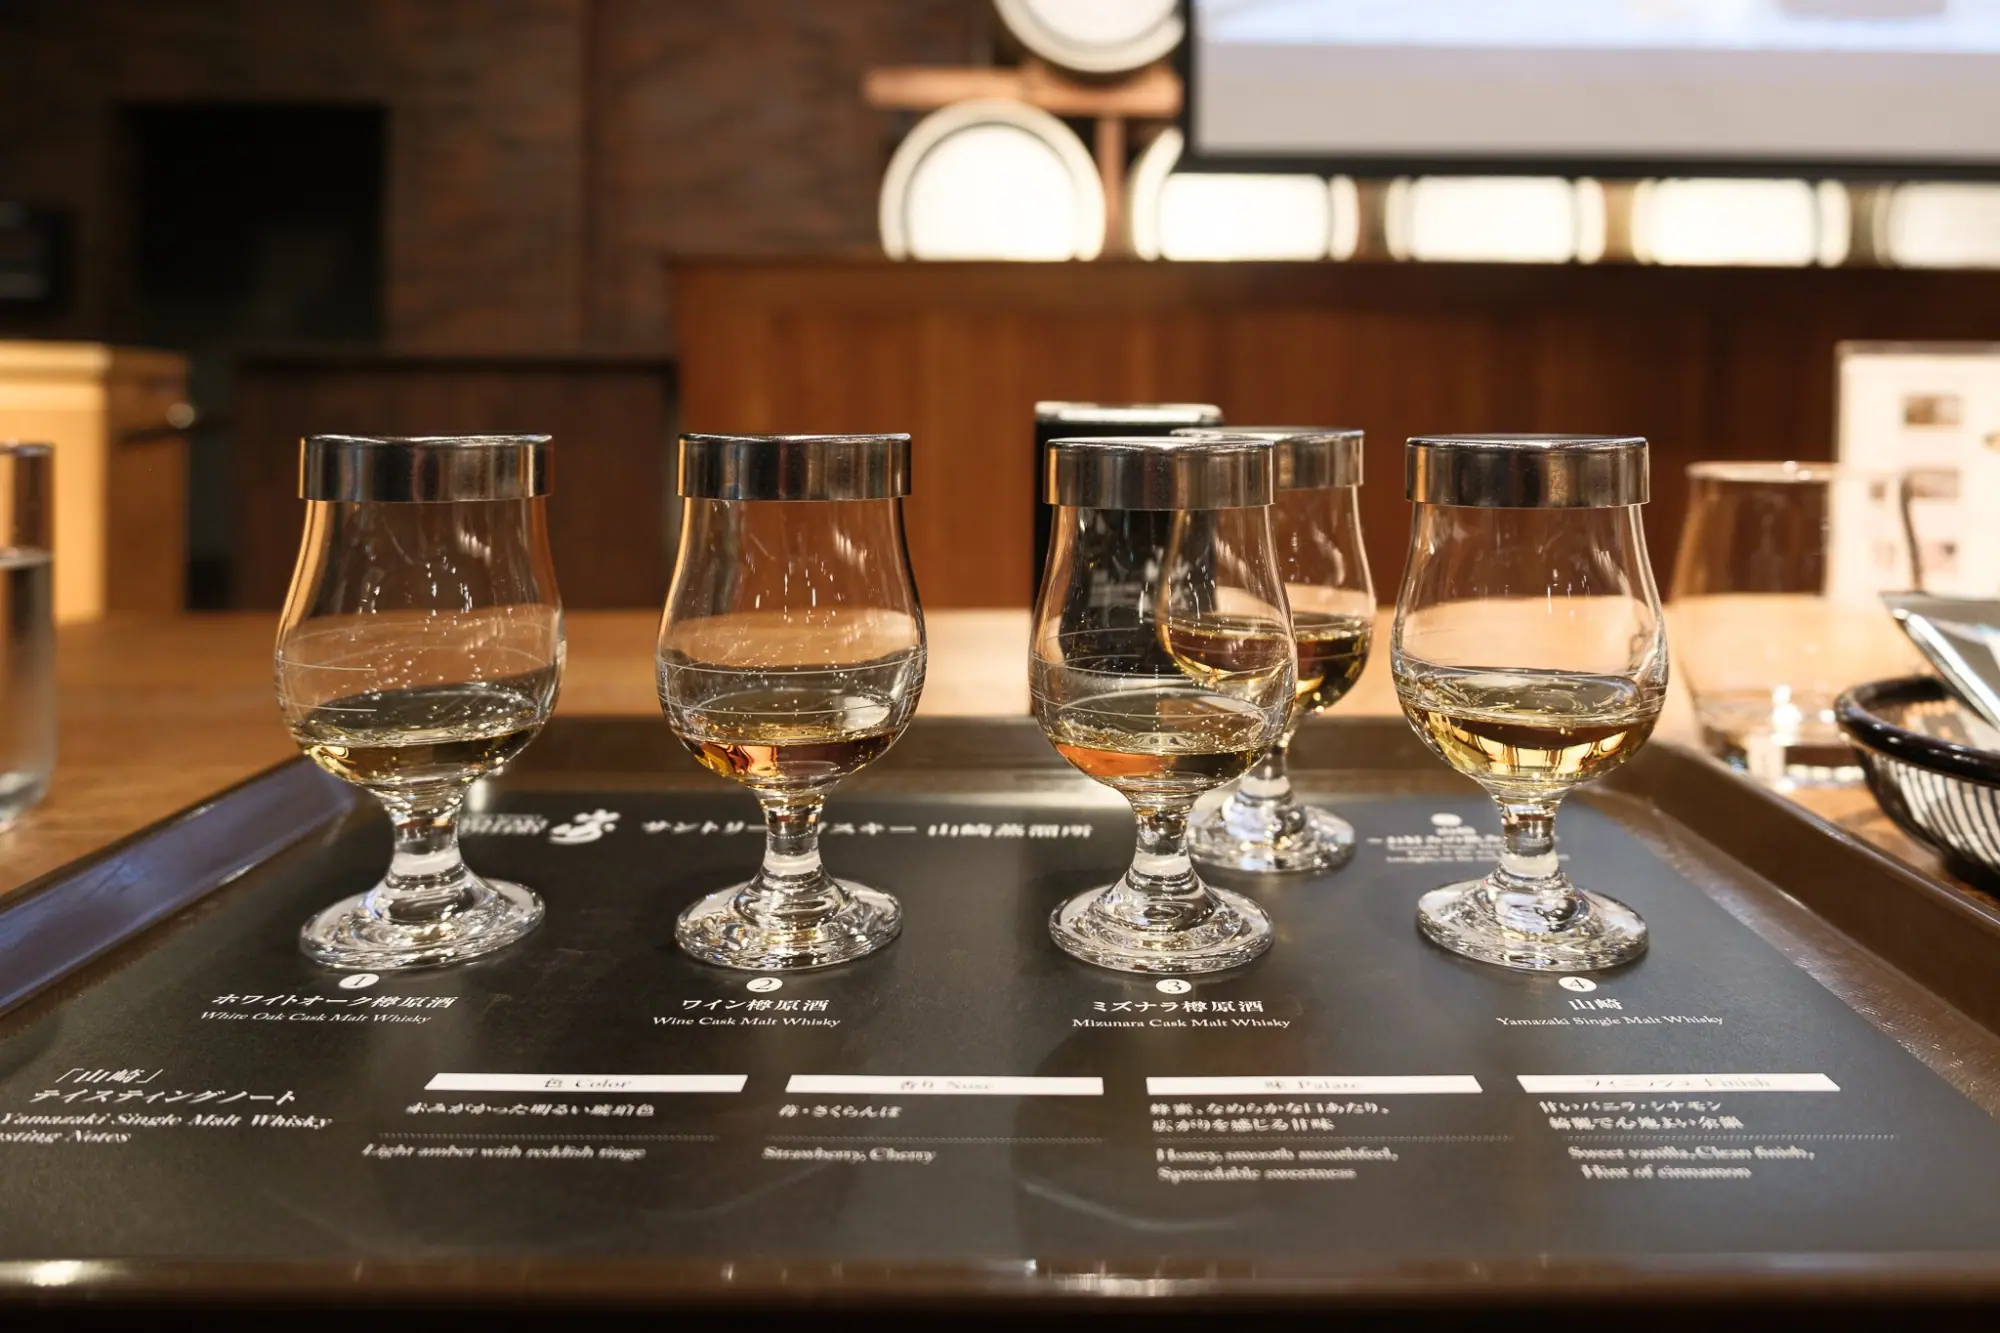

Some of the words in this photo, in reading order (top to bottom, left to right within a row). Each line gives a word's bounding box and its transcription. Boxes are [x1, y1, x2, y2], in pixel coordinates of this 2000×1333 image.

[211, 993, 459, 1009] ホワイトオーク樽原酒
[682, 998, 830, 1012] ワイン樽原酒
[1093, 1000, 1264, 1013] ミズナラ樽原酒
[1567, 998, 1624, 1011] 山崎
[200, 1011, 249, 1020] White
[251, 1012, 286, 1021] Oak
[288, 1012, 327, 1022] Cask
[328, 1013, 369, 1022] Malt
[373, 1014, 432, 1025] Whisky
[653, 1016, 695, 1025] Wine
[698, 1016, 736, 1026] Cask
[739, 1017, 778, 1026] Malt
[782, 1017, 841, 1028] Whisky
[1072, 1018, 1144, 1027] Mizunara
[1148, 1018, 1188, 1028] Cask
[1190, 1018, 1228, 1027] Malt
[1230, 1018, 1291, 1029] Whisky
[1495, 1017, 1571, 1026] Yamazaki
[1572, 1016, 1622, 1027] Single
[1621, 1015, 1663, 1025] Malt
[1660, 1015, 1723, 1026] Whisky
[575, 1079, 632, 1089] Color
[0, 1112, 111, 1125] Yamazaki
[110, 1112, 183, 1127] Single
[187, 1113, 242, 1127] Malt
[250, 1114, 333, 1130] Whisky
[64, 1129, 132, 1143] Notes
